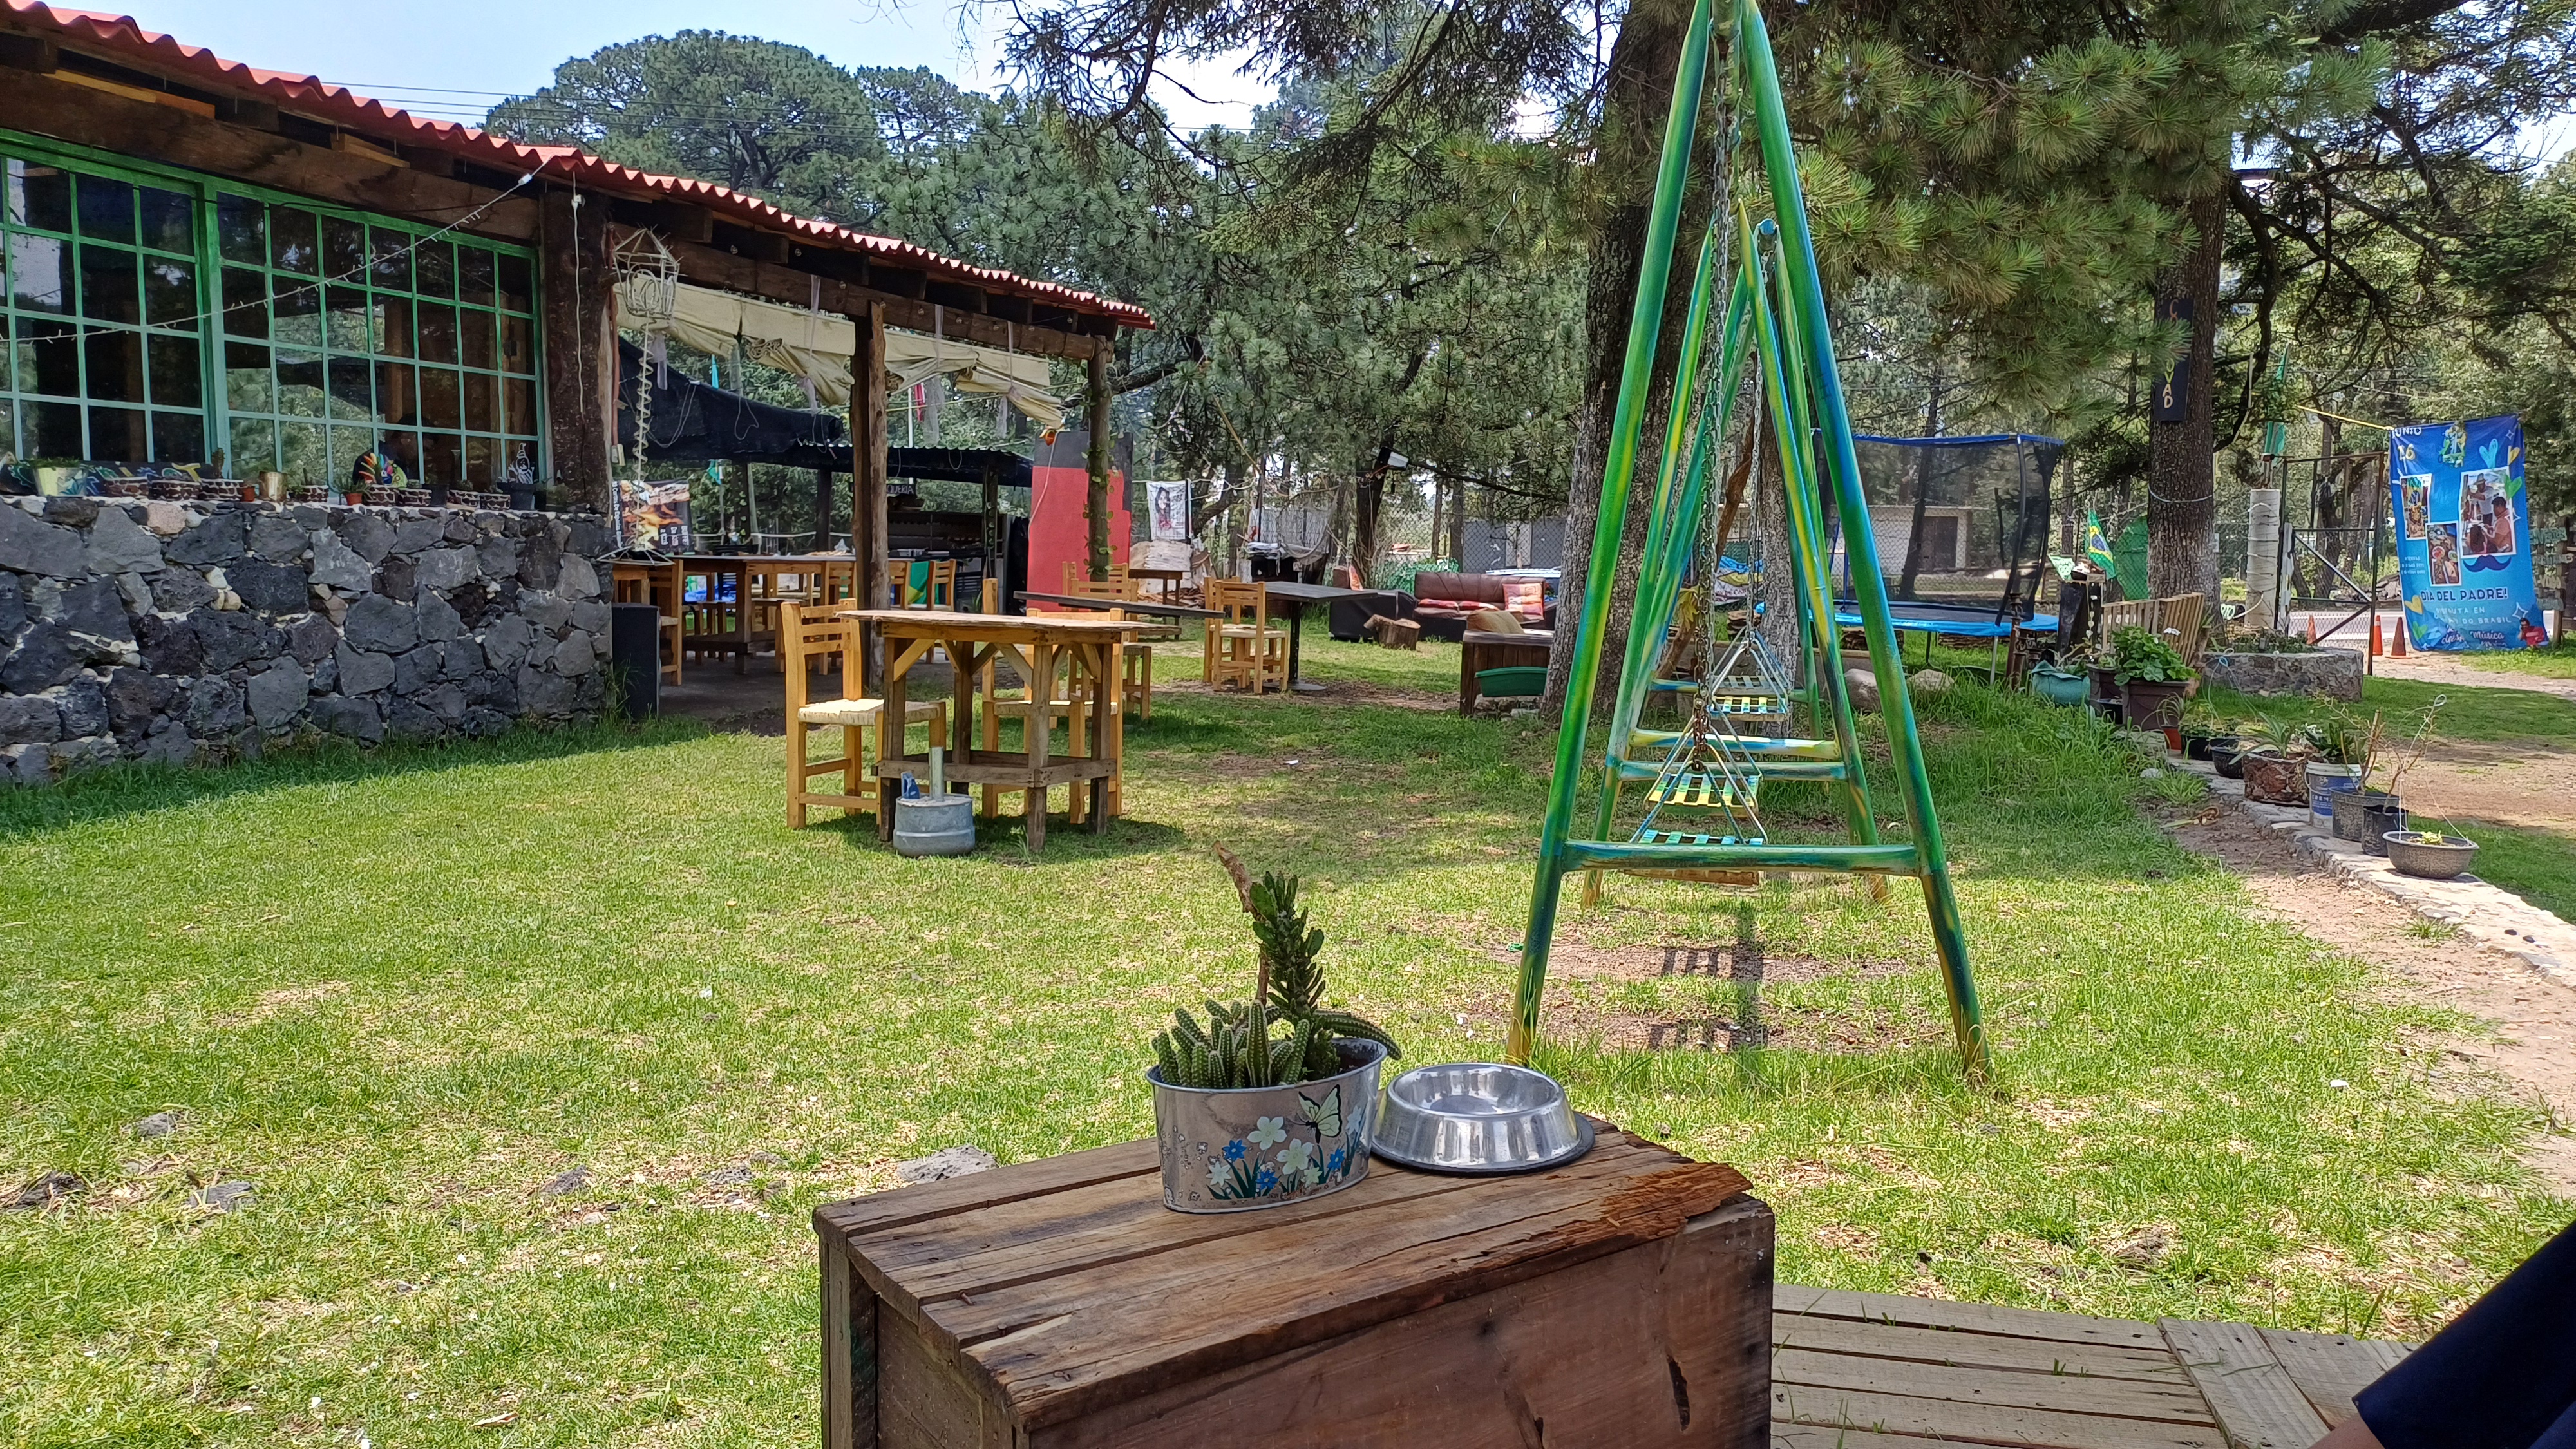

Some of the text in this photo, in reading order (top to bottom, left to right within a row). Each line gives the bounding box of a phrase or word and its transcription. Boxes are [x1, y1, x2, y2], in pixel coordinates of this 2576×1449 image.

[887, 484, 914, 495] QUERIA
[2437, 591, 2457, 601] DEL
[2460, 587, 2509, 601] PADRE!
[2477, 616, 2512, 625] BRASIL
